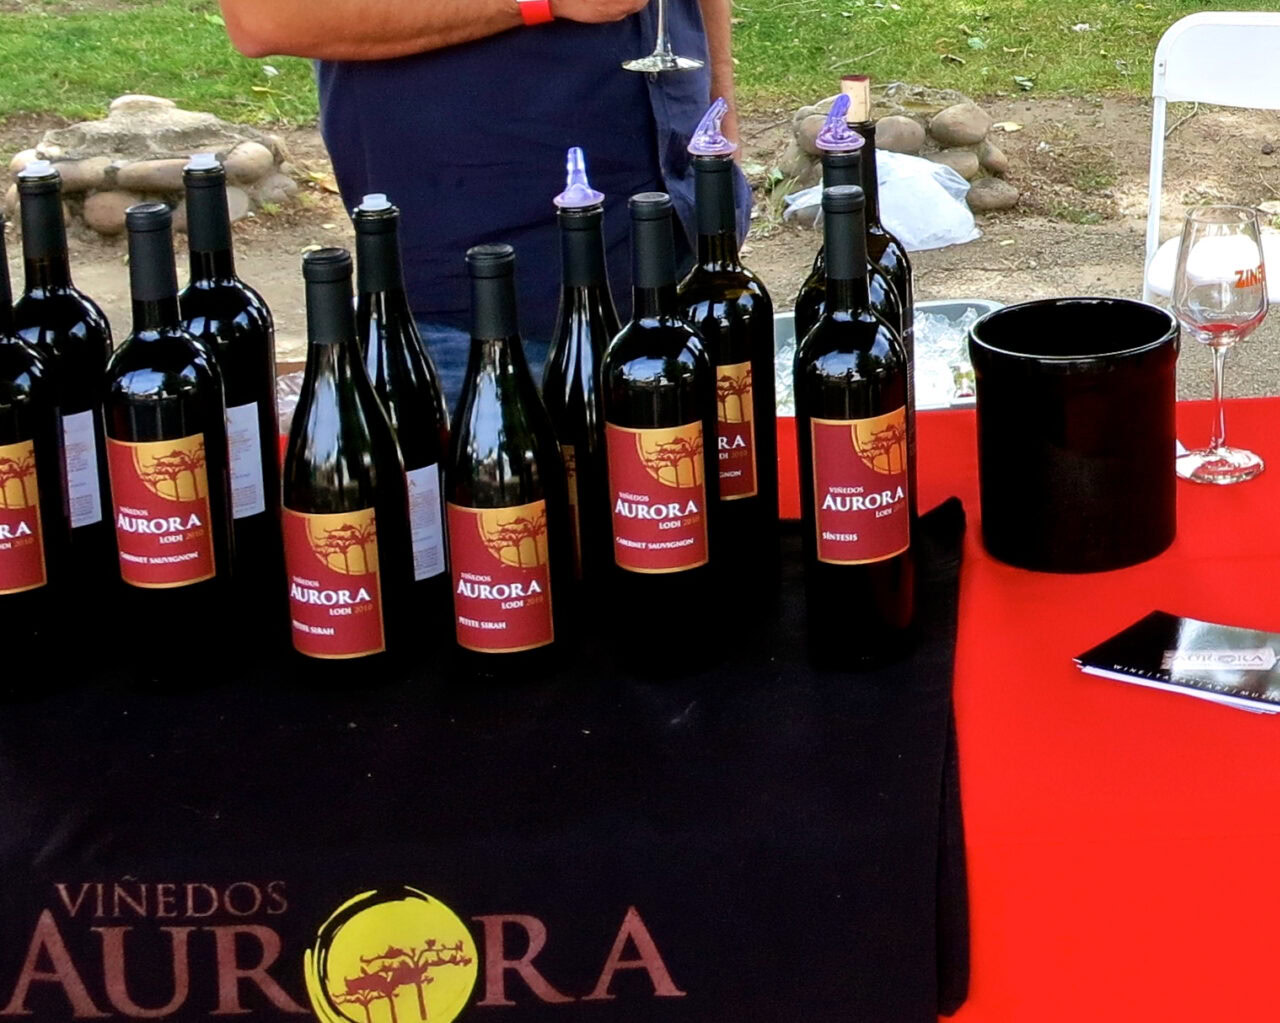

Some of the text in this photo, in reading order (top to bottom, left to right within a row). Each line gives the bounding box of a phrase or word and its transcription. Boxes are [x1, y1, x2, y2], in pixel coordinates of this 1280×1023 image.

[821, 485, 905, 511] AURORA
[614, 498, 698, 520] AURORA
[117, 513, 202, 534] AURORA
[659, 520, 682, 530] LODI
[159, 534, 184, 544] LODI
[822, 531, 858, 542] SÍNTESIS
[647, 537, 695, 550] SAUVIGNON
[149, 551, 199, 565] SAUVIGNON
[290, 582, 371, 606] AURORA
[456, 579, 542, 600] AURORA
[501, 600, 524, 610] LODI
[329, 607, 352, 617] LODI
[310, 626, 335, 636] SIRAH
[480, 621, 507, 630] SIRAH
[54, 875, 289, 919] VIÑEDOS
